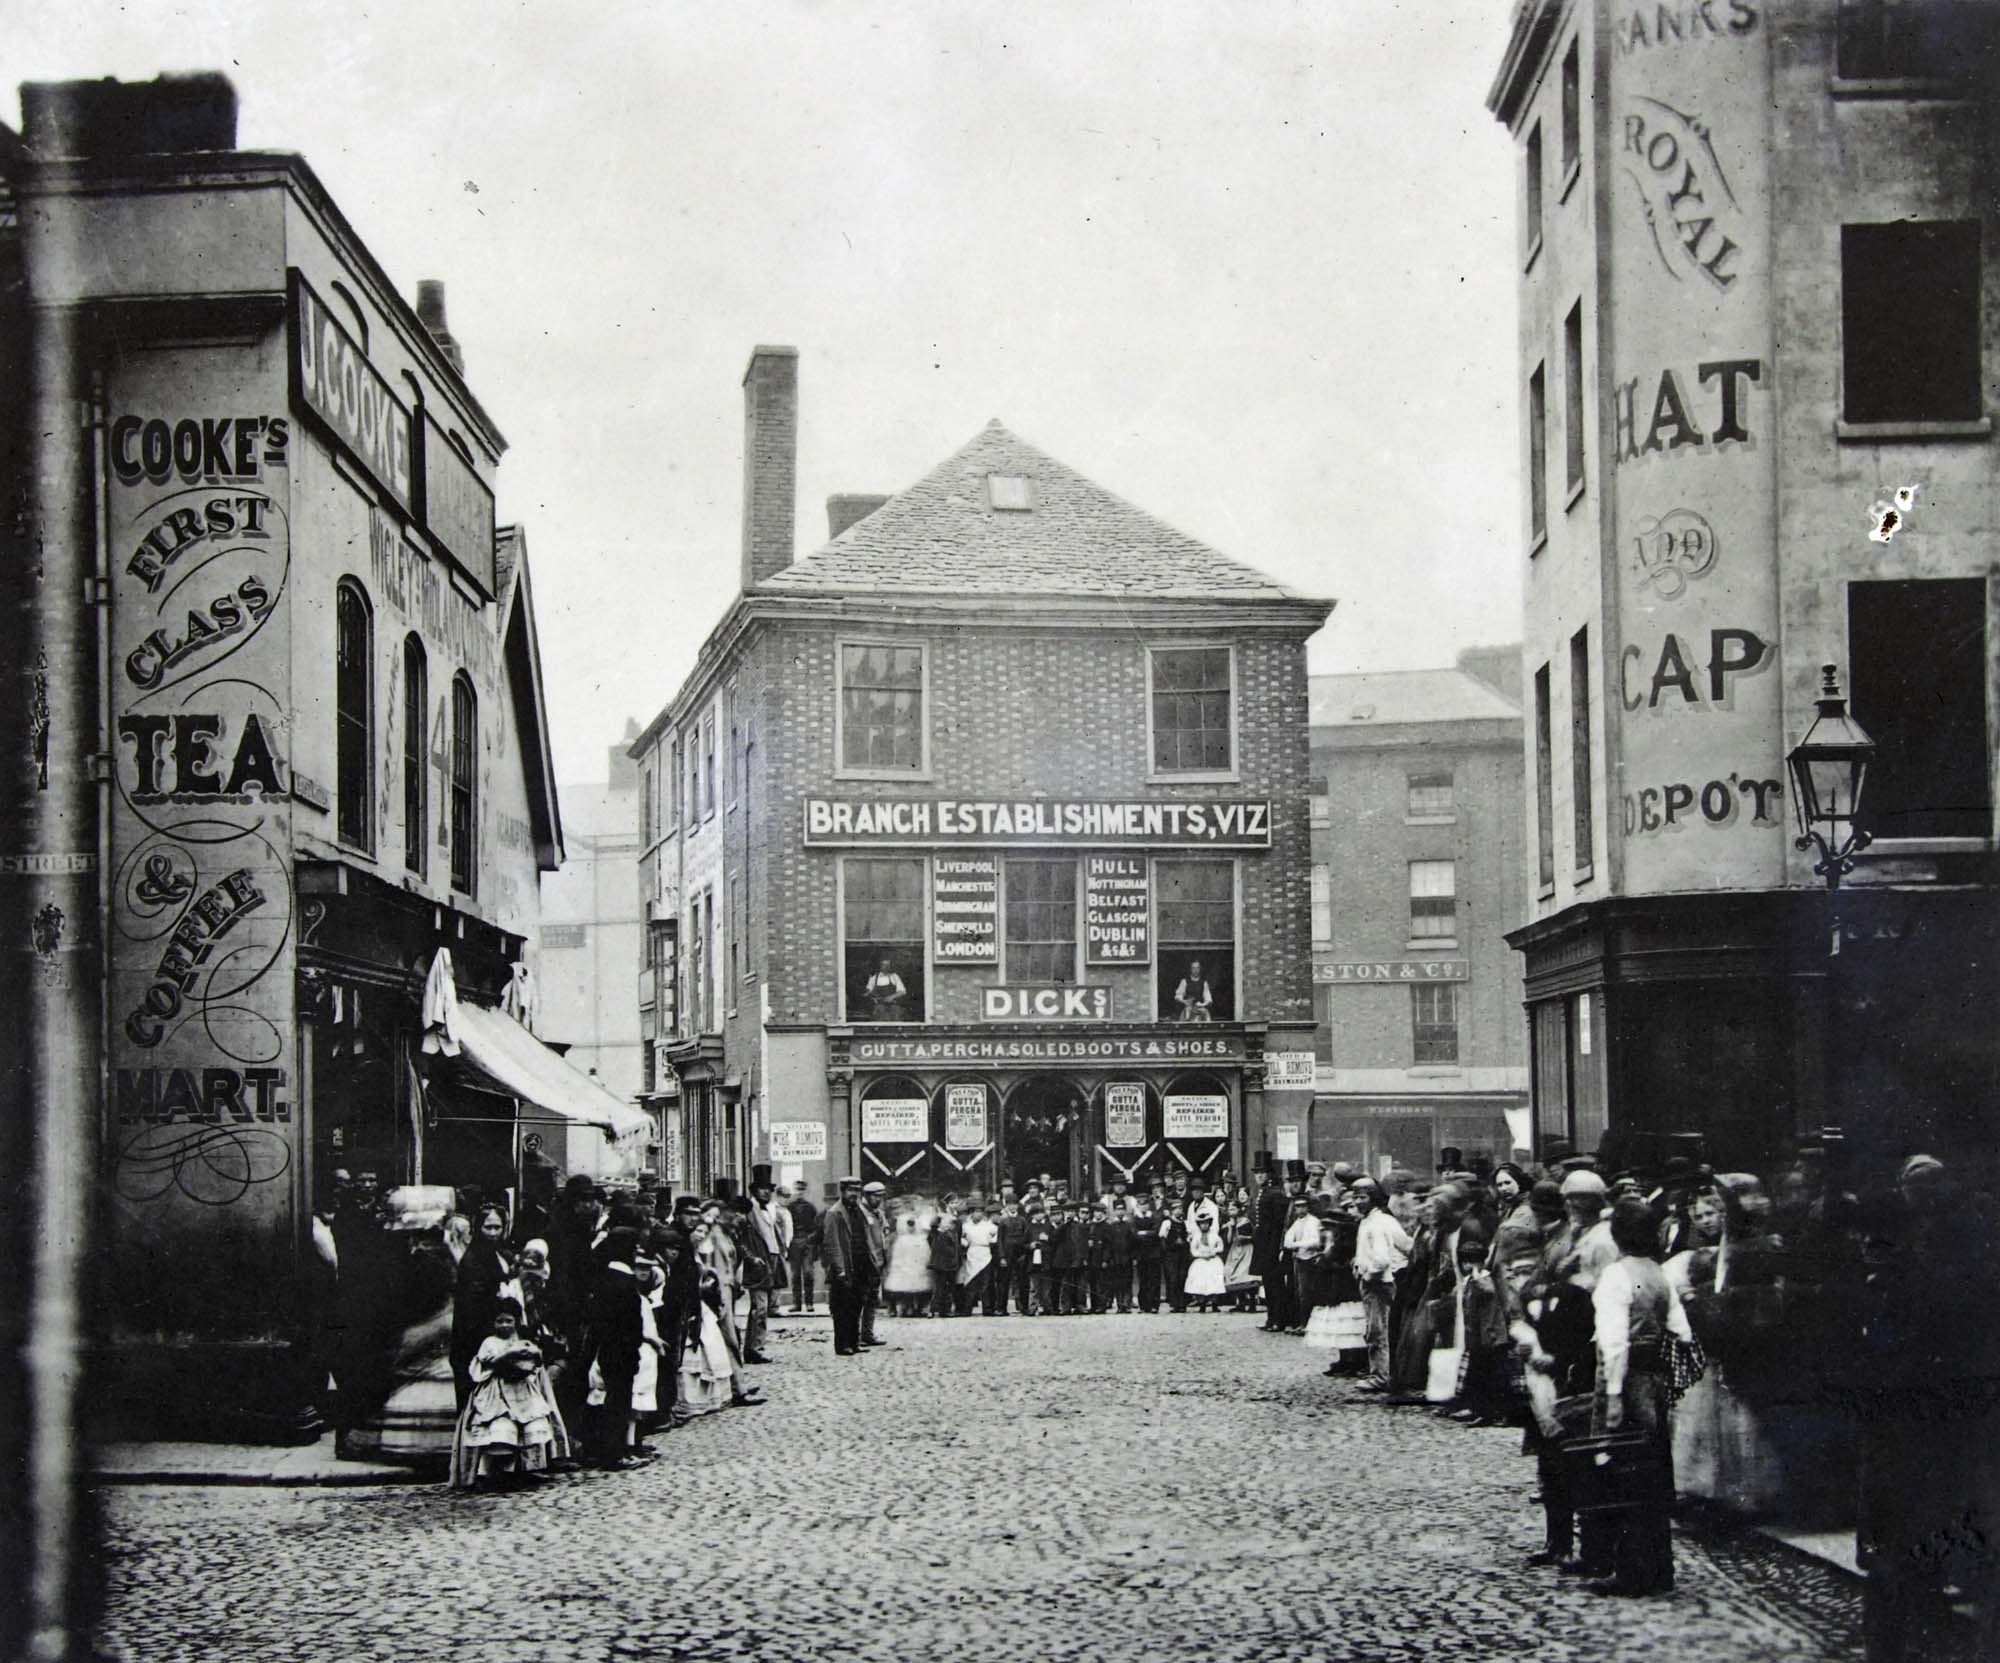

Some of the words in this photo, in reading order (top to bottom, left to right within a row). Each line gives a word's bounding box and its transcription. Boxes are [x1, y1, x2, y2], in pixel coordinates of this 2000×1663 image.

[1624, 115, 1738, 285] ROYAL
[1615, 359, 1766, 463] HAT
[126, 498, 273, 594] FIRST
[126, 575, 272, 690] CLASS
[1621, 629, 1772, 712] CAP
[118, 713, 291, 805] TEA
[809, 800, 931, 834] BRANCH
[935, 860, 995, 873] LIVERPOOL
[1091, 859, 1139, 874] HULL
[136, 855, 193, 905] &
[1087, 878, 1147, 890] NOTTINGHAM
[1088, 893, 1146, 907] BELFAST
[1088, 910, 1148, 923] GLASGOW
[1089, 926, 1146, 941] DUBLIN
[126, 869, 266, 1048] COFFEE
[936, 940, 995, 956] LONDON
[1400, 964, 1415, 978] &
[1146, 1041, 1160, 1055] &
